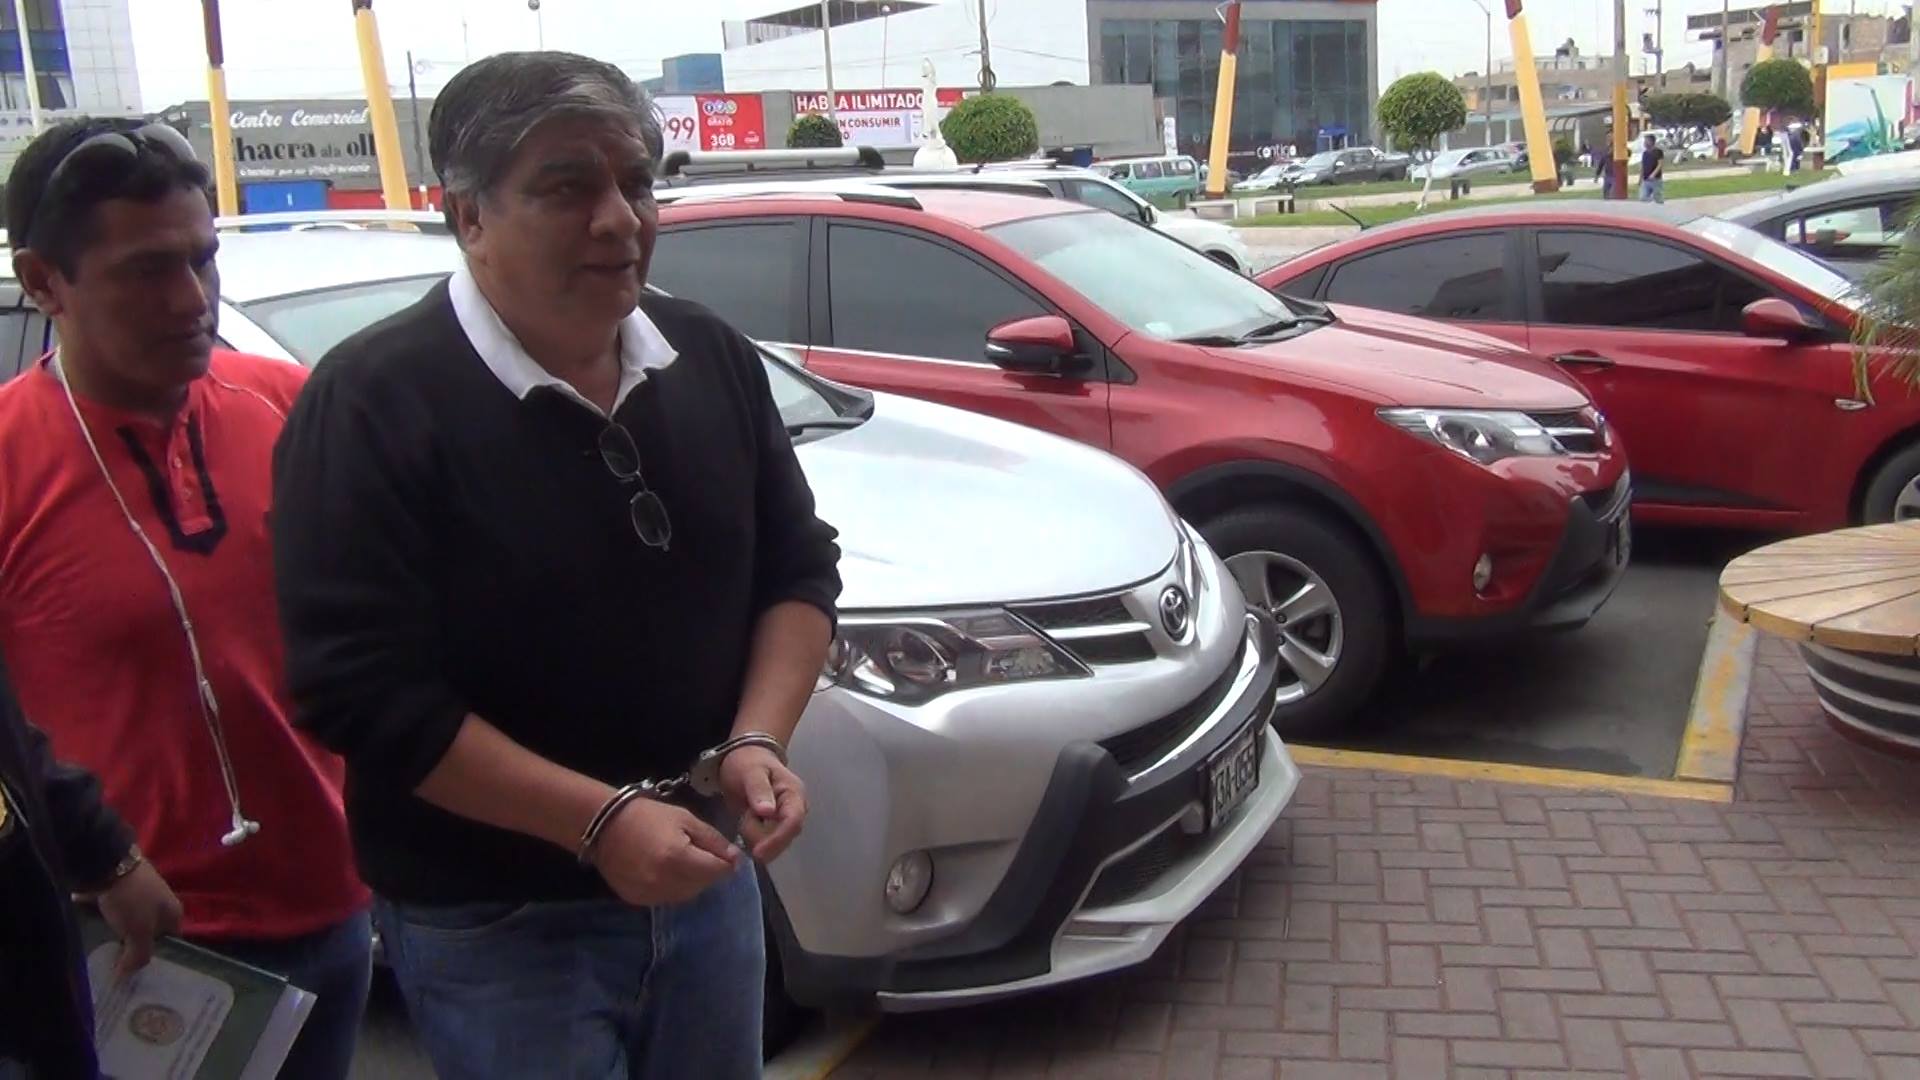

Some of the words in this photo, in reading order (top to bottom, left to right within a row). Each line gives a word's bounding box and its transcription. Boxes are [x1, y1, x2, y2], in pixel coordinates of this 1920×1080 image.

[797, 95, 849, 111] HABA
[852, 93, 925, 109] ILIMITADO
[230, 110, 282, 128] Centro
[290, 108, 368, 126] Comercial
[849, 117, 901, 128] CONSUMIR
[231, 136, 315, 162] hacra
[347, 133, 376, 157] oll
[710, 133, 735, 146] 3GB
[1256, 143, 1297, 159] contigo
